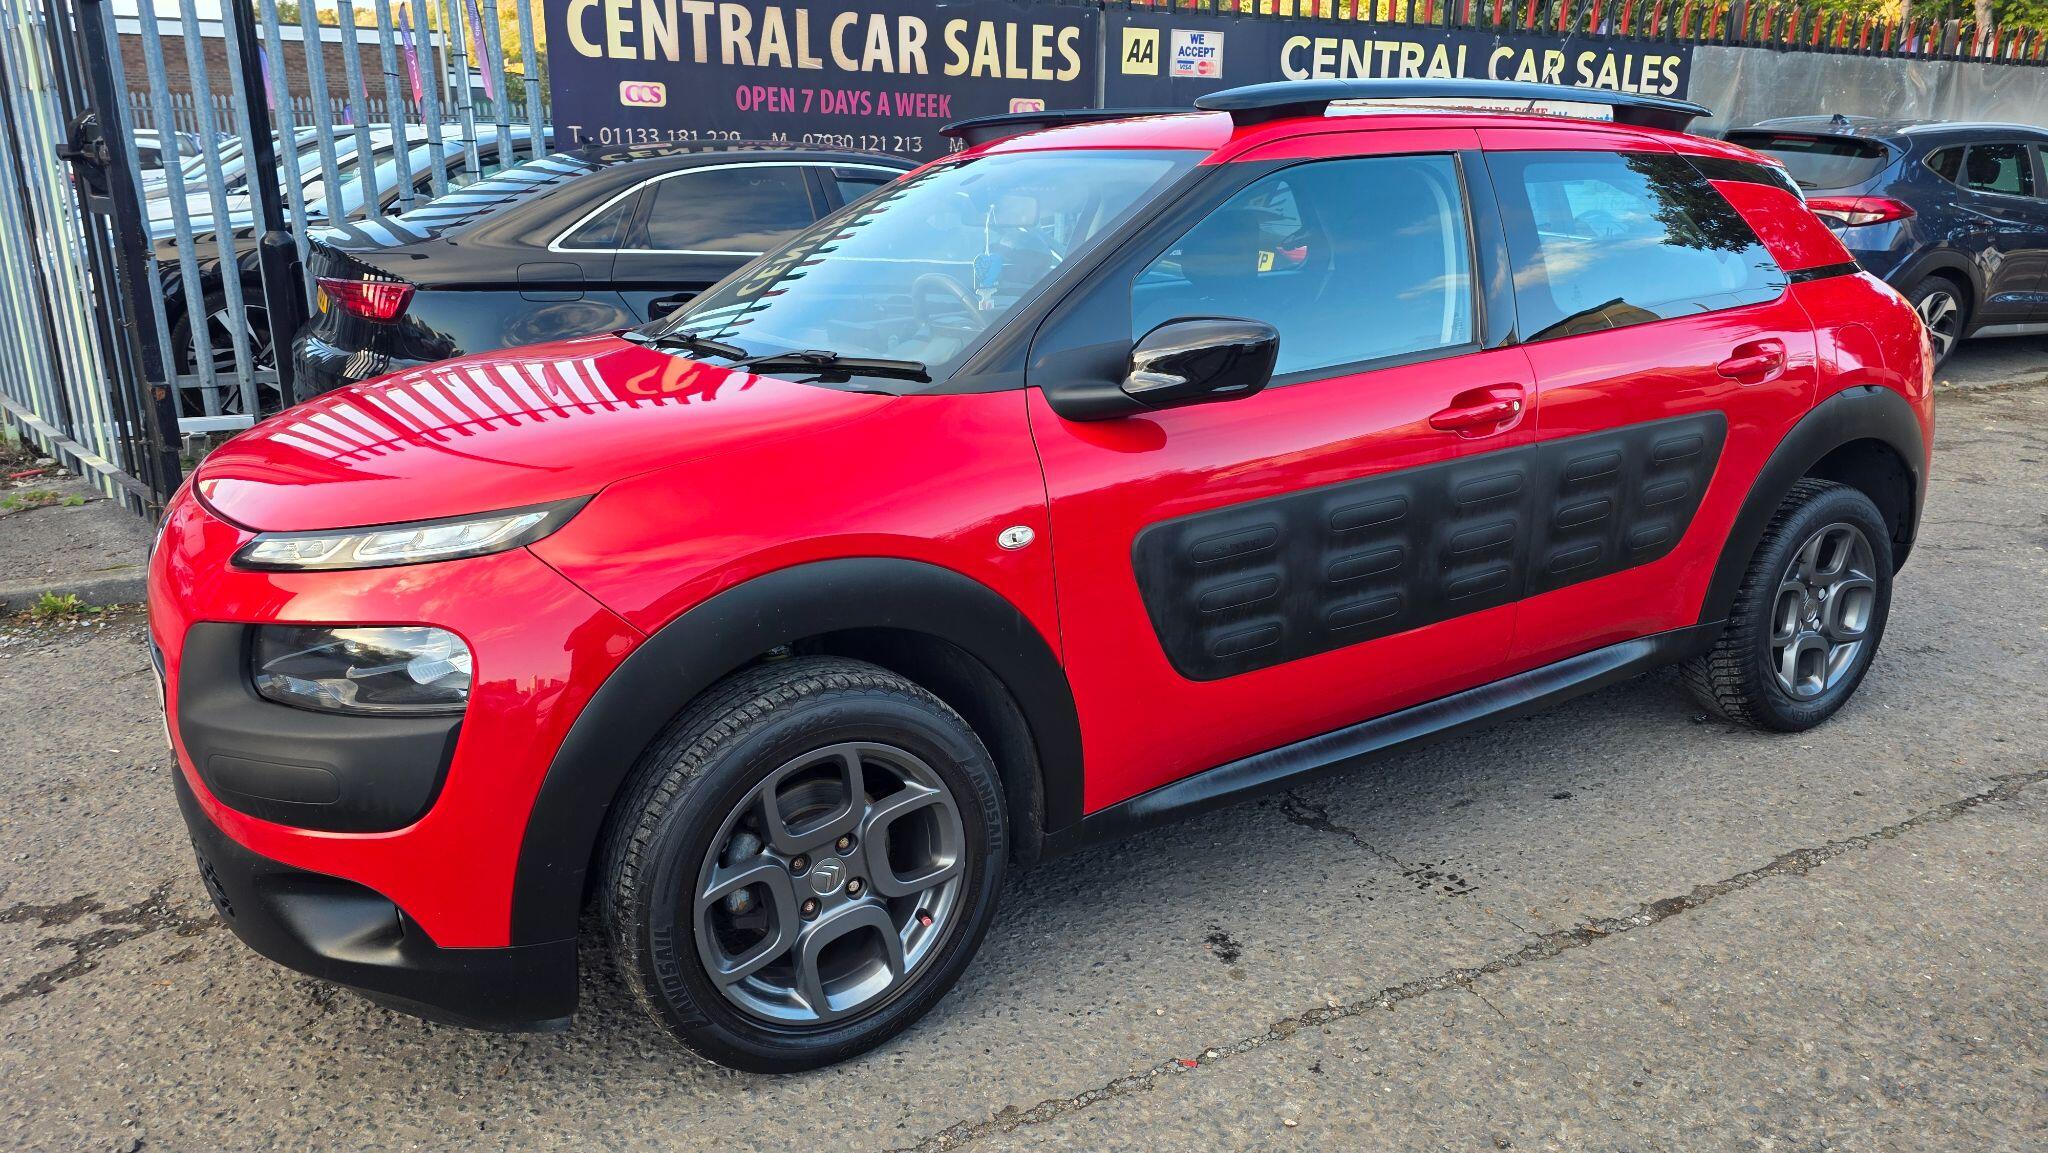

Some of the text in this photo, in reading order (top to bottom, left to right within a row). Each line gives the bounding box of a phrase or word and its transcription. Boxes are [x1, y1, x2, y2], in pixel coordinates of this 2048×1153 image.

[567, 0, 1081, 82] CENTRAL CAR SALES
[1126, 38, 1154, 63] AA
[1178, 46, 1215, 57] ACCEPT
[1190, 33, 1204, 45] WE
[1488, 46, 1565, 85] CAR
[1574, 51, 1681, 96] SALES
[736, 85, 951, 118] OPEN 7 DAYS A WEEK
[599, 126, 659, 145] 01133
[668, 128, 698, 142] 181
[802, 133, 854, 149] 07930
[860, 135, 887, 151] 121
[894, 136, 924, 153] 213
